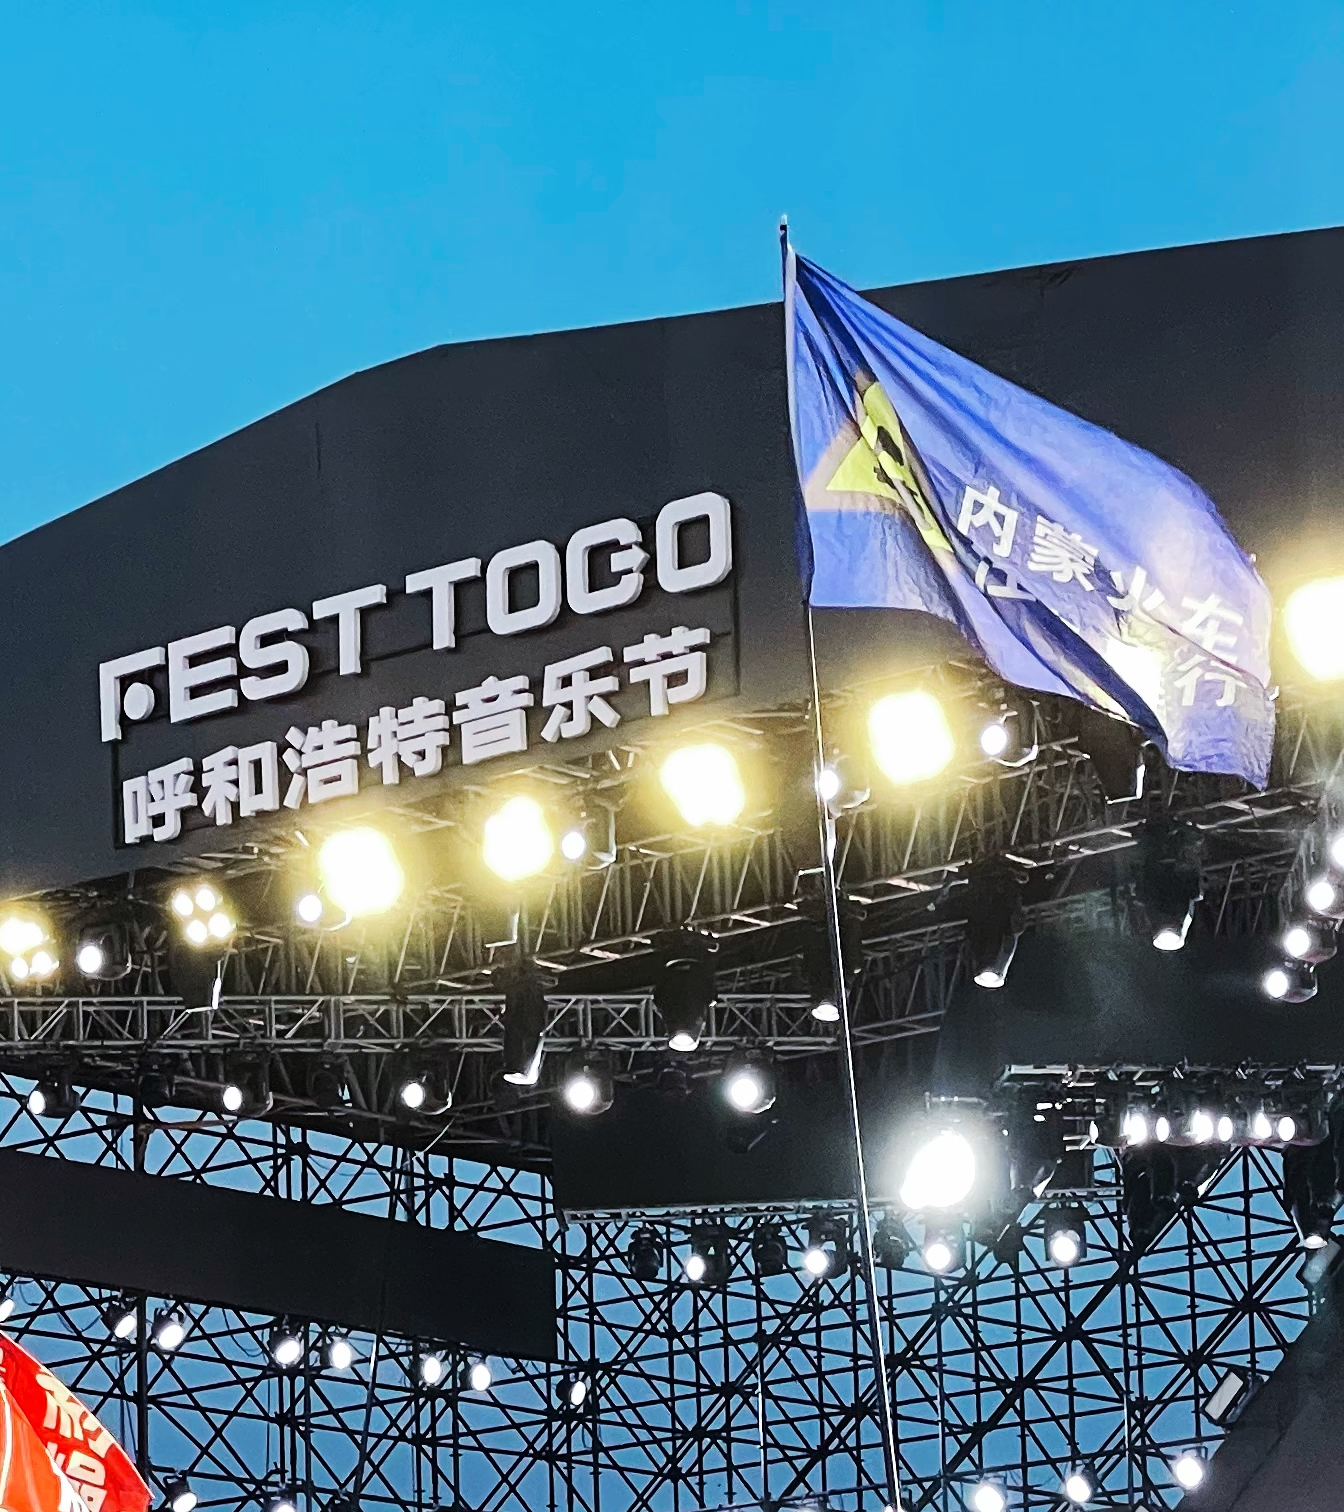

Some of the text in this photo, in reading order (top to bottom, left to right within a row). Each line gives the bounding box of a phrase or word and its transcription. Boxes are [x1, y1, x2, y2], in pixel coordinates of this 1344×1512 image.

[99, 490, 733, 743] FEST TOGO
[121, 625, 712, 846] 呼和浩特音乐节
